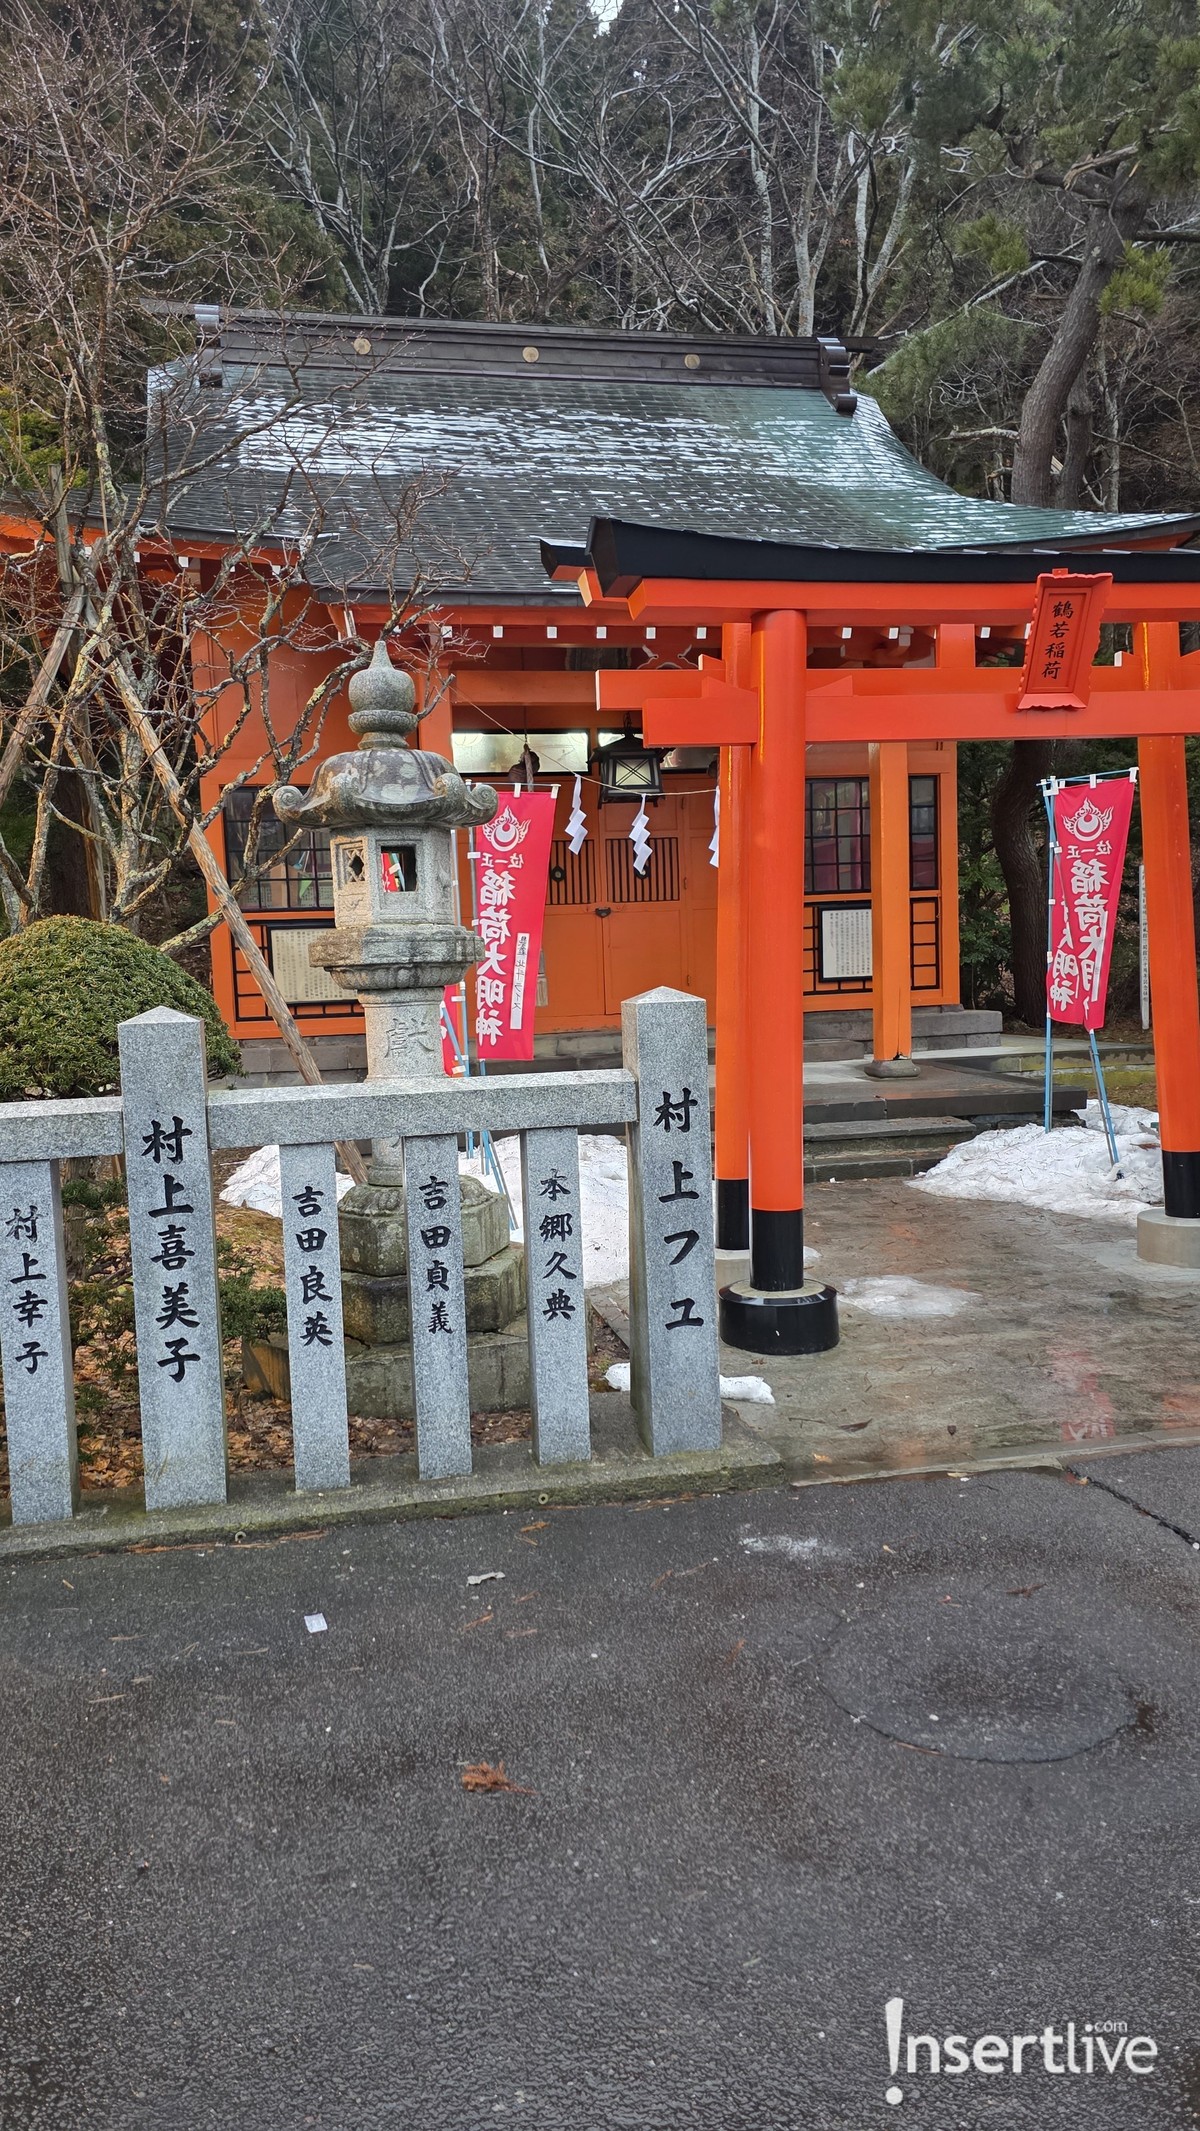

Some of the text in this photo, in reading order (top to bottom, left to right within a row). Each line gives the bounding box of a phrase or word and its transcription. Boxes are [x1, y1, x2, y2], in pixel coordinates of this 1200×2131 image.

[1042, 601, 1074, 679] 鶴若稲荷
[5, 1205, 49, 1375] 村上幸子
[142, 1115, 201, 1383] 村上喜美子
[292, 1185, 333, 1347] 吉田良英
[418, 1175, 453, 1335] 吉田貞義
[539, 1168, 577, 1322] 本郷久典
[653, 1087, 704, 1331] 村上フユ
